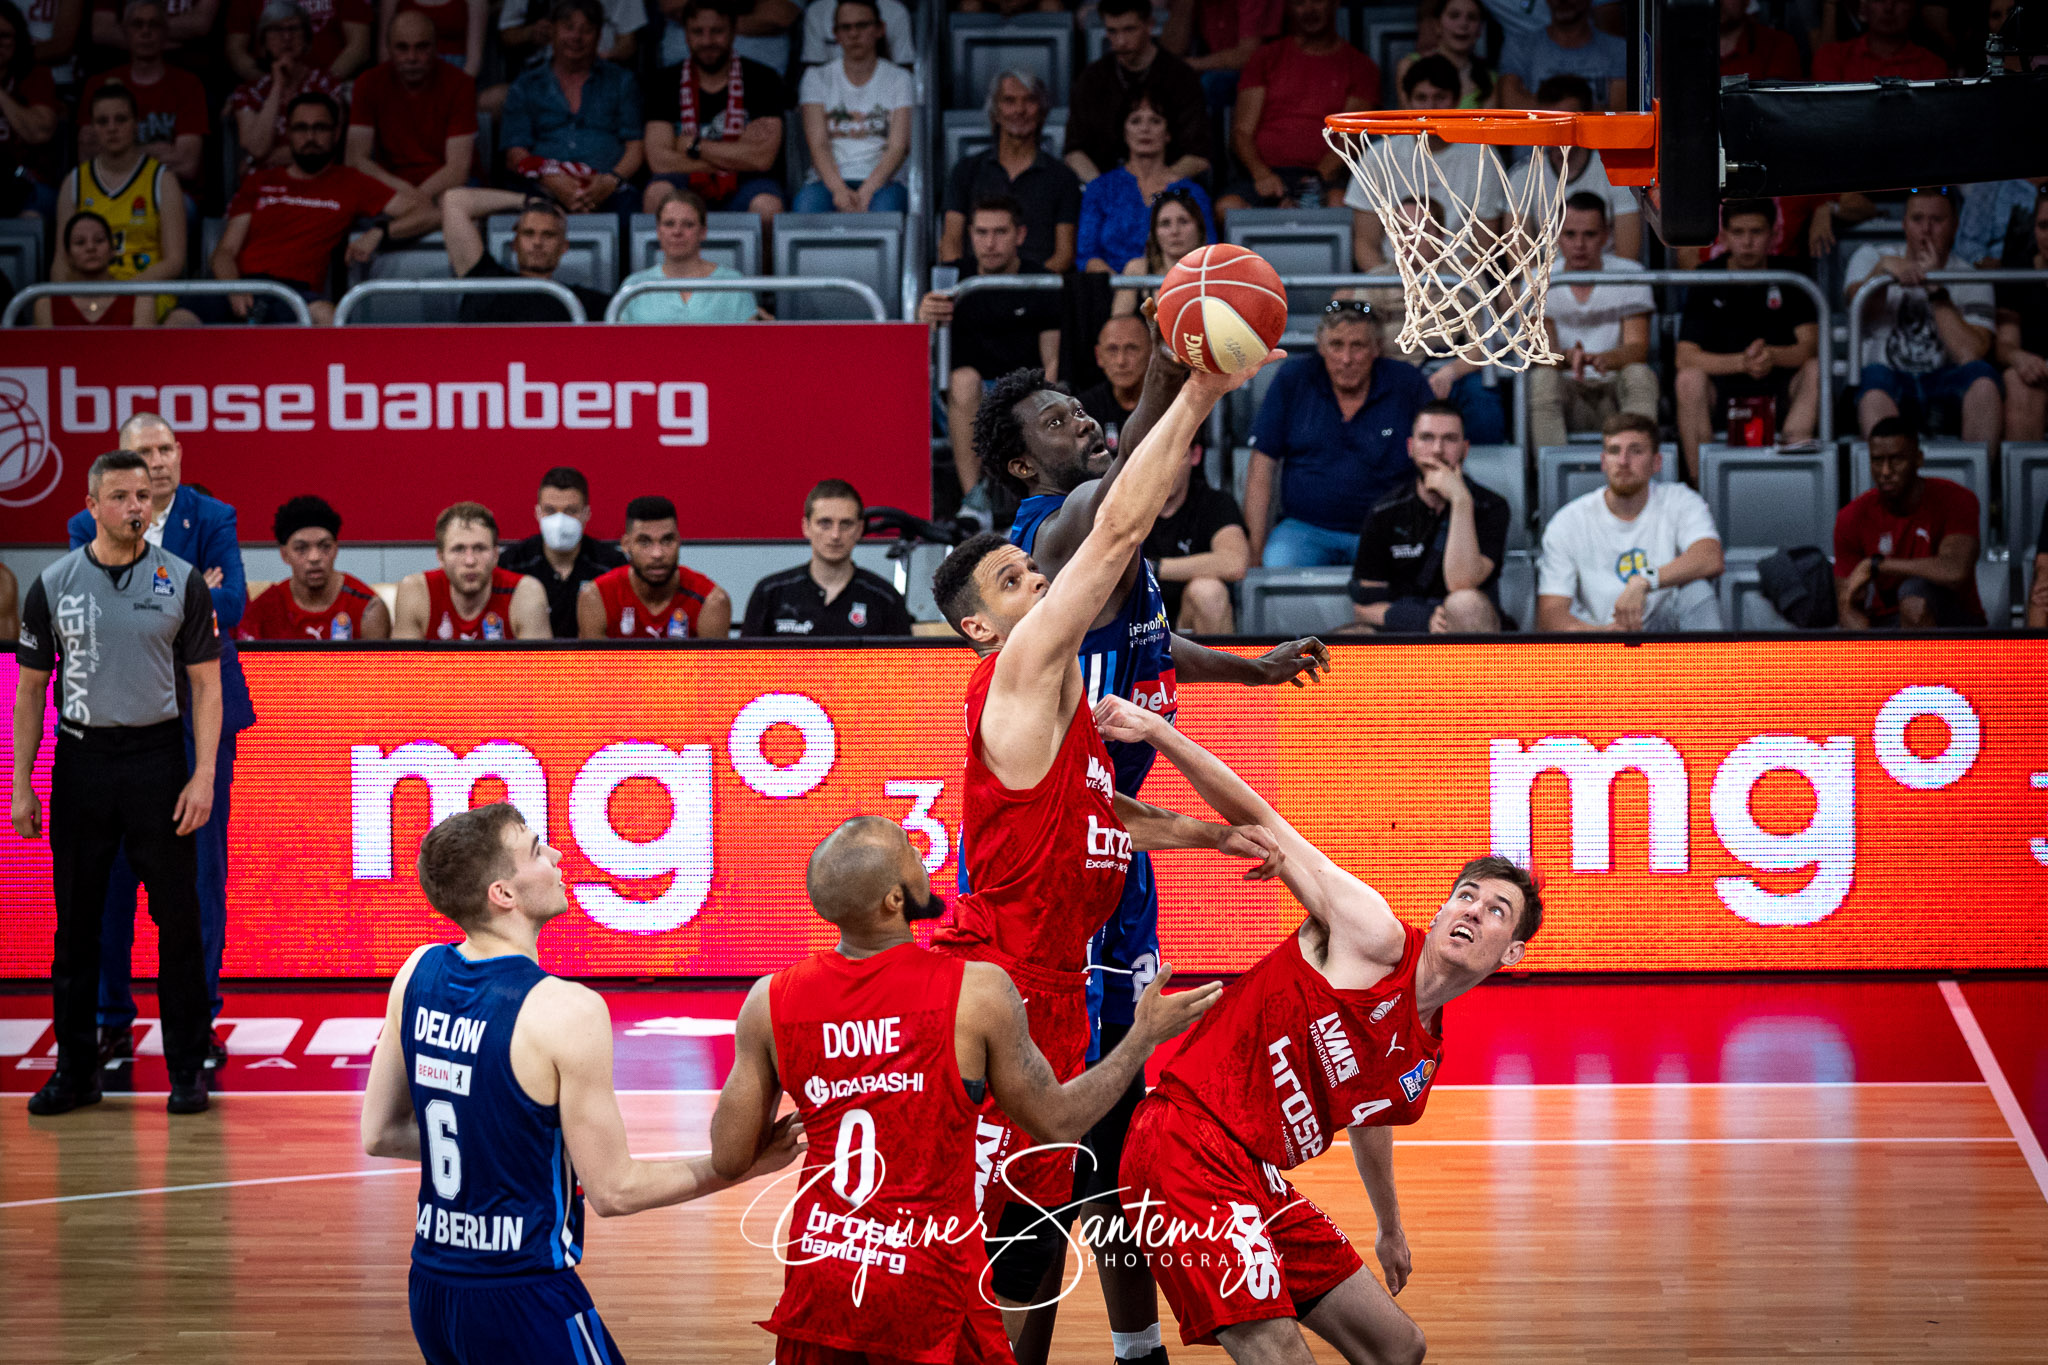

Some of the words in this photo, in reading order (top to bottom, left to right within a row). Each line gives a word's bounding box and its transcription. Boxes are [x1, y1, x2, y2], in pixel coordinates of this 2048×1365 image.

[60, 367, 315, 433] brose
[328, 362, 708, 446] bamberg
[57, 593, 91, 725] GYMPER
[414, 1006, 487, 1054] DELOW
[822, 1016, 901, 1059] DOWE
[418, 1064, 449, 1081] BERLIN
[1308, 1022, 1338, 1089] VERSICHERUNG
[830, 1072, 924, 1099] IGARASHI
[1402, 1075, 1418, 1098] BBL
[1351, 1098, 1393, 1127] 4
[425, 1098, 462, 1200] 6
[832, 1108, 876, 1208] 0
[992, 1160, 1004, 1183] rent
[1003, 1127, 1012, 1147] car
[435, 1207, 524, 1251] BERLIN
[806, 1202, 908, 1248] brose
[800, 1231, 907, 1275] bamberg
